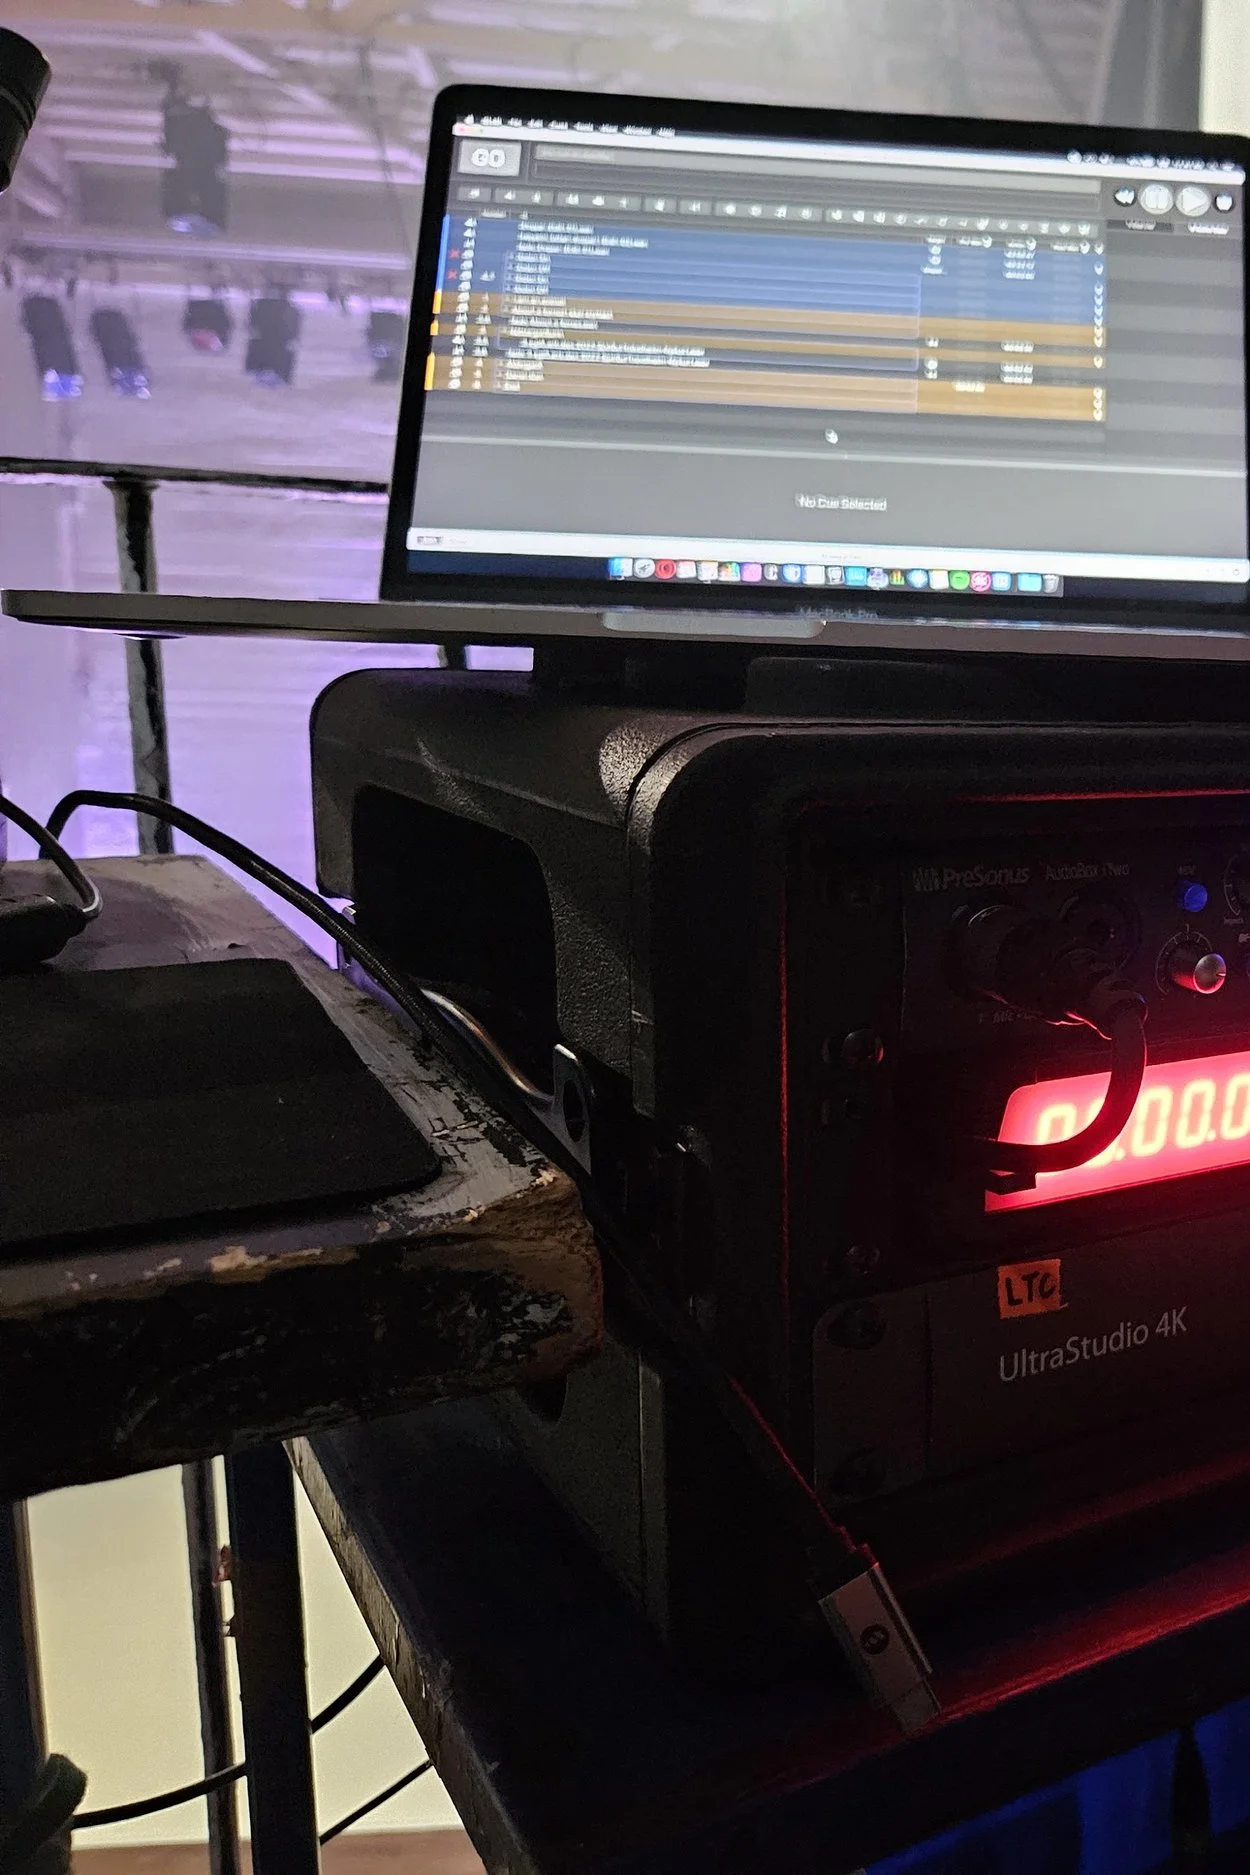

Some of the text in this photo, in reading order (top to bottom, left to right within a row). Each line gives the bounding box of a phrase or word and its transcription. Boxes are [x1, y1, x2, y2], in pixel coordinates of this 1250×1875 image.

[943, 863, 1030, 889] PreSonus
[1005, 1271, 1058, 1306] LTC
[1000, 1306, 1188, 1382] UltraStudio 4K
